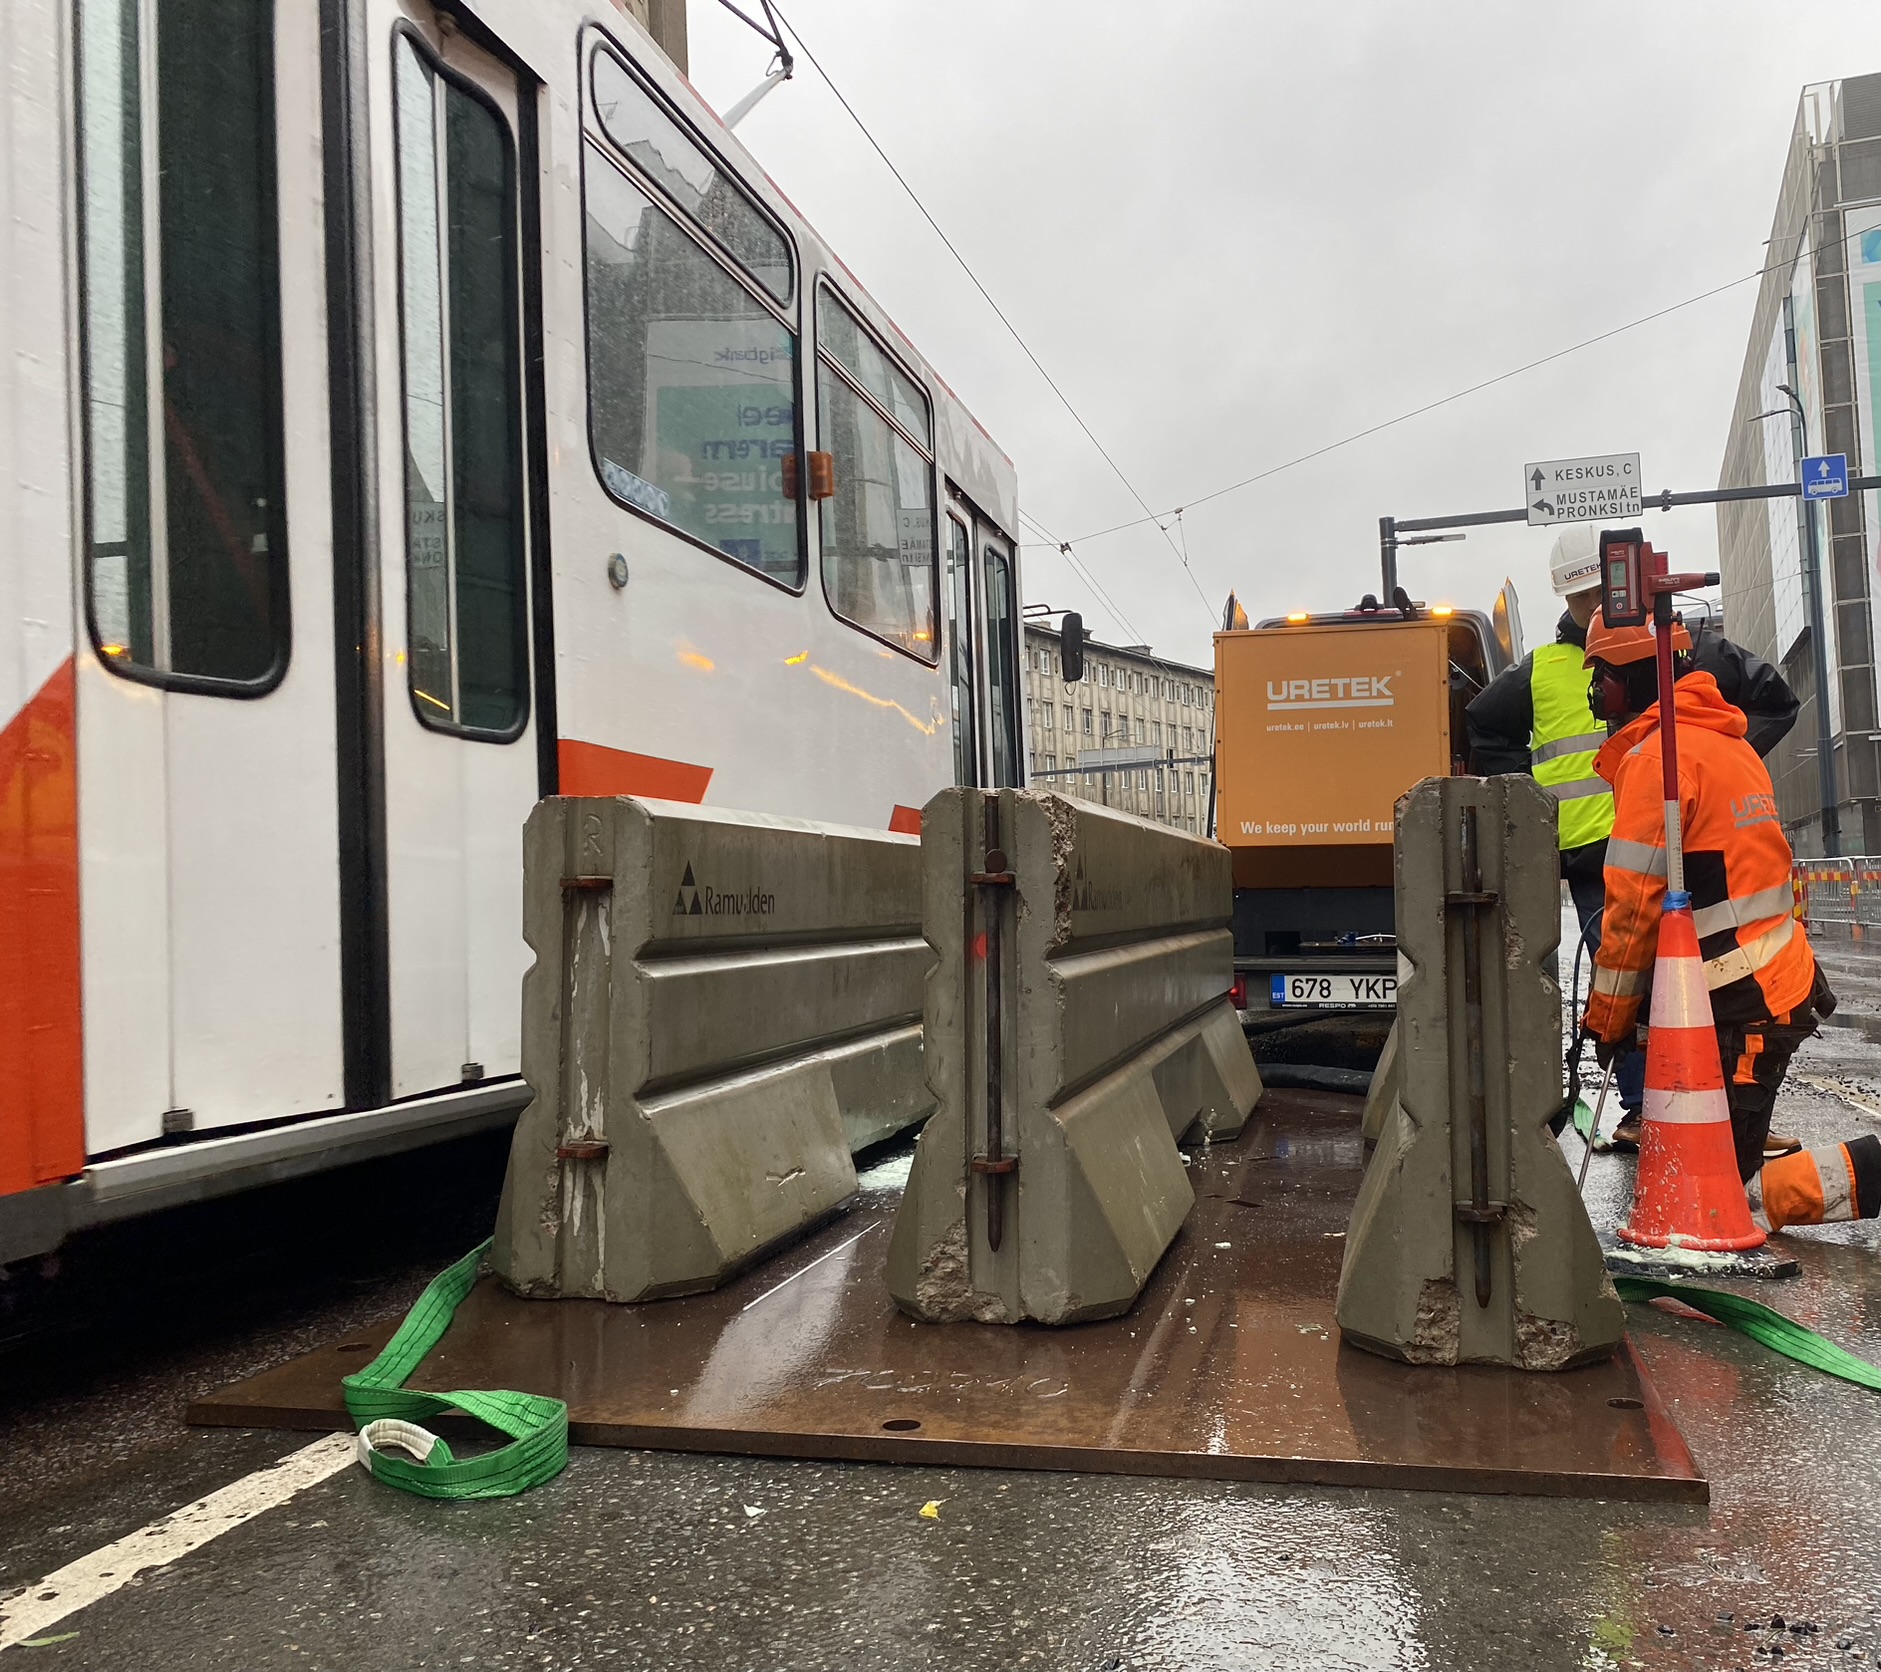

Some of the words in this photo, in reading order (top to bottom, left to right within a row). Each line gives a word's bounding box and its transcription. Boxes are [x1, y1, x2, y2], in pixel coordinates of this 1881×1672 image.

[1555, 464, 1620, 481] KESKUS,
[1623, 462, 1632, 475] C
[1556, 485, 1639, 505] MUSTAMÄE
[1564, 562, 1601, 581] URETEK
[1266, 676, 1394, 701] URETEK
[1266, 721, 1305, 732] uretek.ee
[1313, 720, 1350, 730] uretek.lv
[1358, 718, 1394, 728] uretek.lt
[1240, 821, 1263, 834] We
[1266, 820, 1297, 836] keep
[1300, 822, 1329, 836] your
[1332, 818, 1371, 832] world
[1291, 978, 1331, 999] 678
[1349, 978, 1397, 999] YKP
